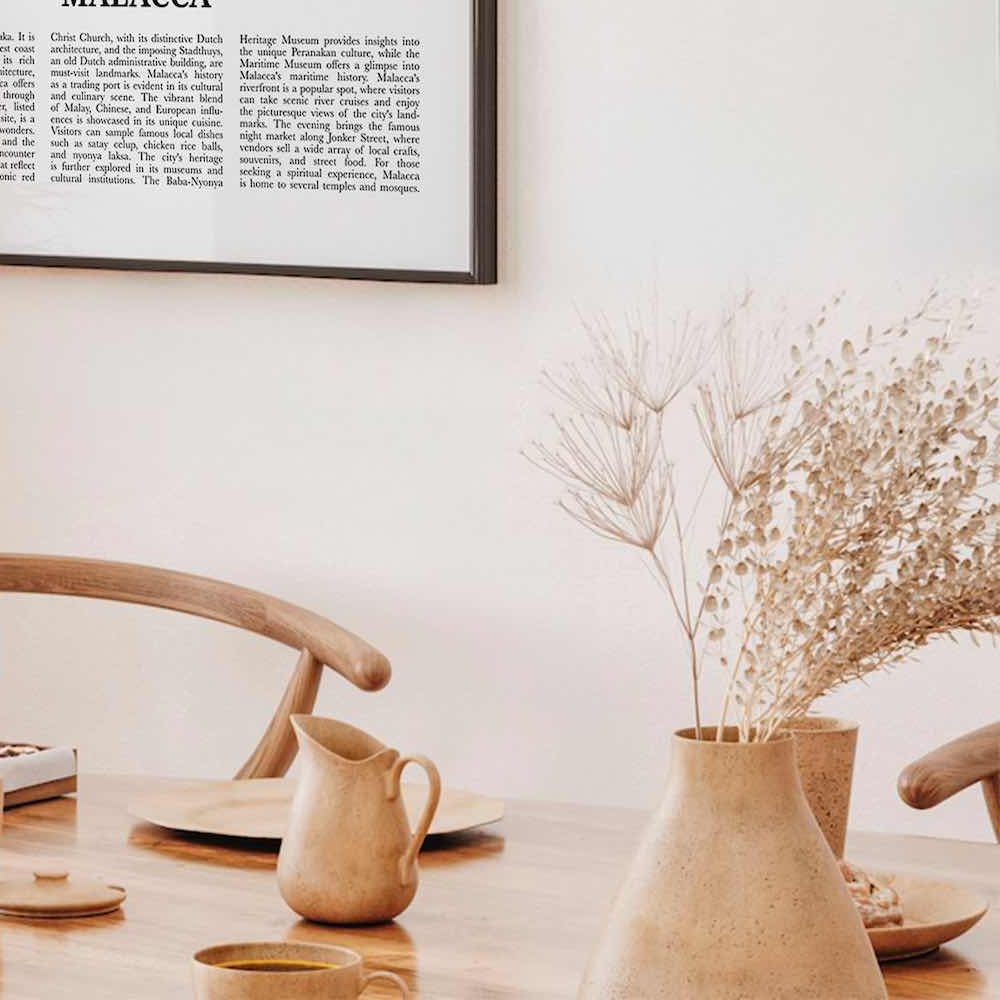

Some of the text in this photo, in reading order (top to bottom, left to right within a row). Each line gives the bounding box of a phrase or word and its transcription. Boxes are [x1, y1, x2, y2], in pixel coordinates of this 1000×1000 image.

[18, 32, 25, 41] It
[28, 32, 35, 41] is
[50, 33, 223, 44] Christ Church, with its distinctive Dutch
[240, 35, 420, 48] Heritage Museum provides insights into
[50, 45, 223, 58] architecture, and the imposing Stadthuys,
[3, 55, 13, 64] its
[19, 55, 35, 64] rich
[64, 56, 77, 66] old
[80, 57, 105, 66] Dutch
[108, 57, 167, 67] administrative
[170, 58, 207, 70] building,
[209, 60, 223, 68] are
[240, 59, 280, 69] Maritime
[284, 60, 322, 69] Museum
[326, 60, 350, 70] offers
[364, 61, 398, 73] glimpse
[402, 61, 420, 70] into
[51, 68, 223, 82] must-visit landmarks. Malacca's history
[240, 71, 420, 84] Malacca's maritime history. Malacca's
[12, 79, 35, 88] offers
[3, 90, 35, 102] through
[50, 92, 66, 101] and
[71, 92, 105, 104] culinary
[141, 93, 158, 102] The
[163, 93, 194, 103] vibrant
[199, 94, 223, 103] blend
[14, 102, 35, 111] listed
[50, 103, 223, 117] of Malay, Chinese, and European influ-
[240, 119, 420, 133] marks. The evening brings the famous
[51, 127, 82, 136] Visitors
[105, 128, 134, 140] sample
[139, 128, 169, 138] famous
[173, 129, 193, 138] local
[197, 130, 223, 139] dishes
[240, 131, 420, 145] night market along Jonker Street, where
[2, 137, 18, 146] and
[22, 137, 35, 146] the
[50, 150, 224, 165] and nyonya laksa. The city's heritage
[240, 155, 420, 168] souvenirs, and street food. For those
[10, 160, 35, 170] reflect
[240, 167, 271, 179] seeking
[287, 168, 322, 181] spiritual
[328, 169, 377, 182] experience,
[382, 171, 420, 181] Malacca
[50, 174, 223, 189] cultural institutions. The Baba-Nyonya
